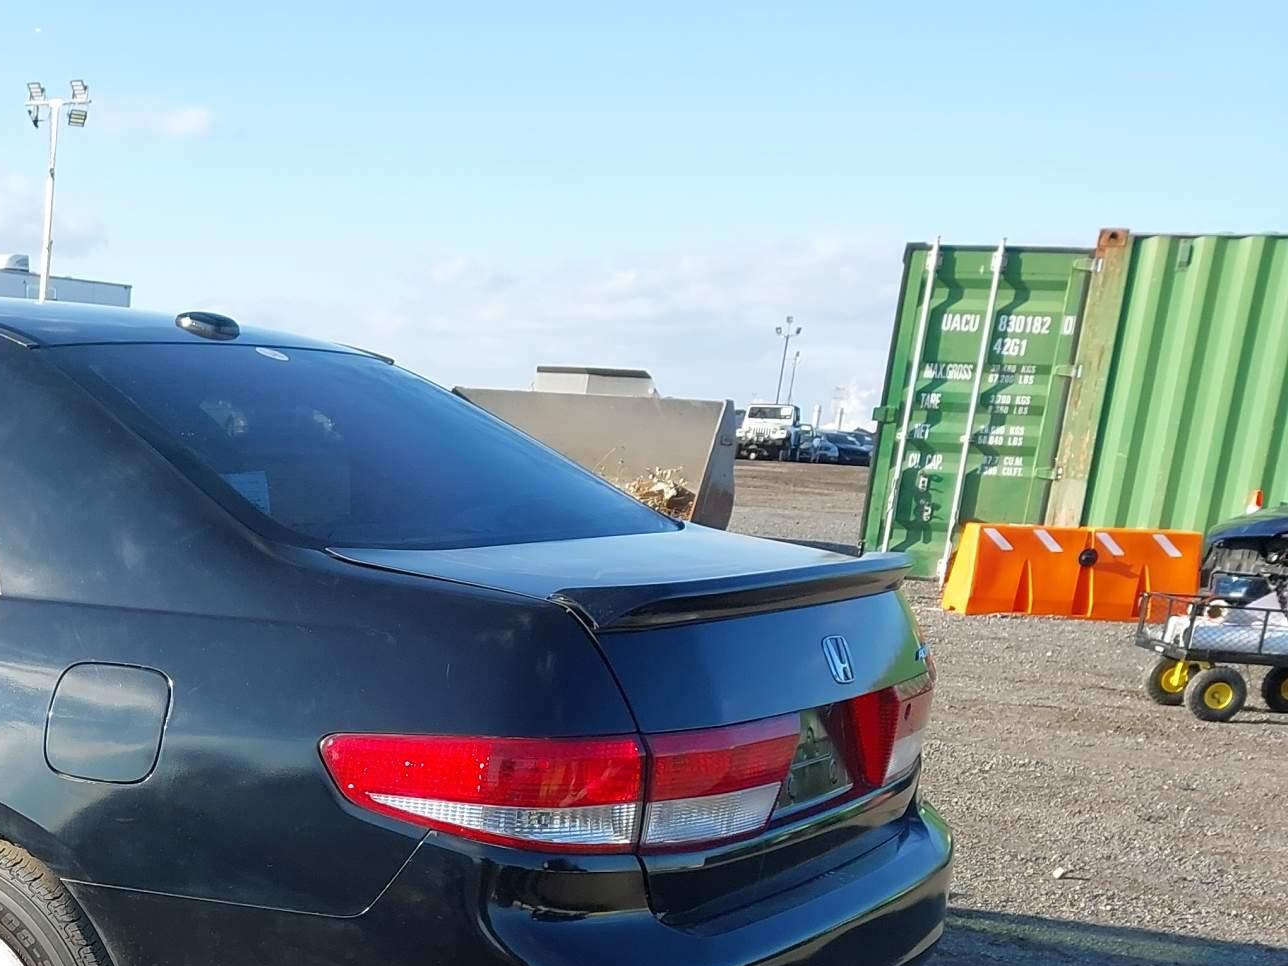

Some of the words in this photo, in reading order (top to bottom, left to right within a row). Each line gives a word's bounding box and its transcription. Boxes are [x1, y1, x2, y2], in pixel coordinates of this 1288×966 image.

[942, 313, 980, 332] UACU
[998, 314, 1052, 334] 830182
[993, 338, 1027, 356] 42G1
[920, 393, 941, 409] TARE
[914, 424, 931, 439] NET
